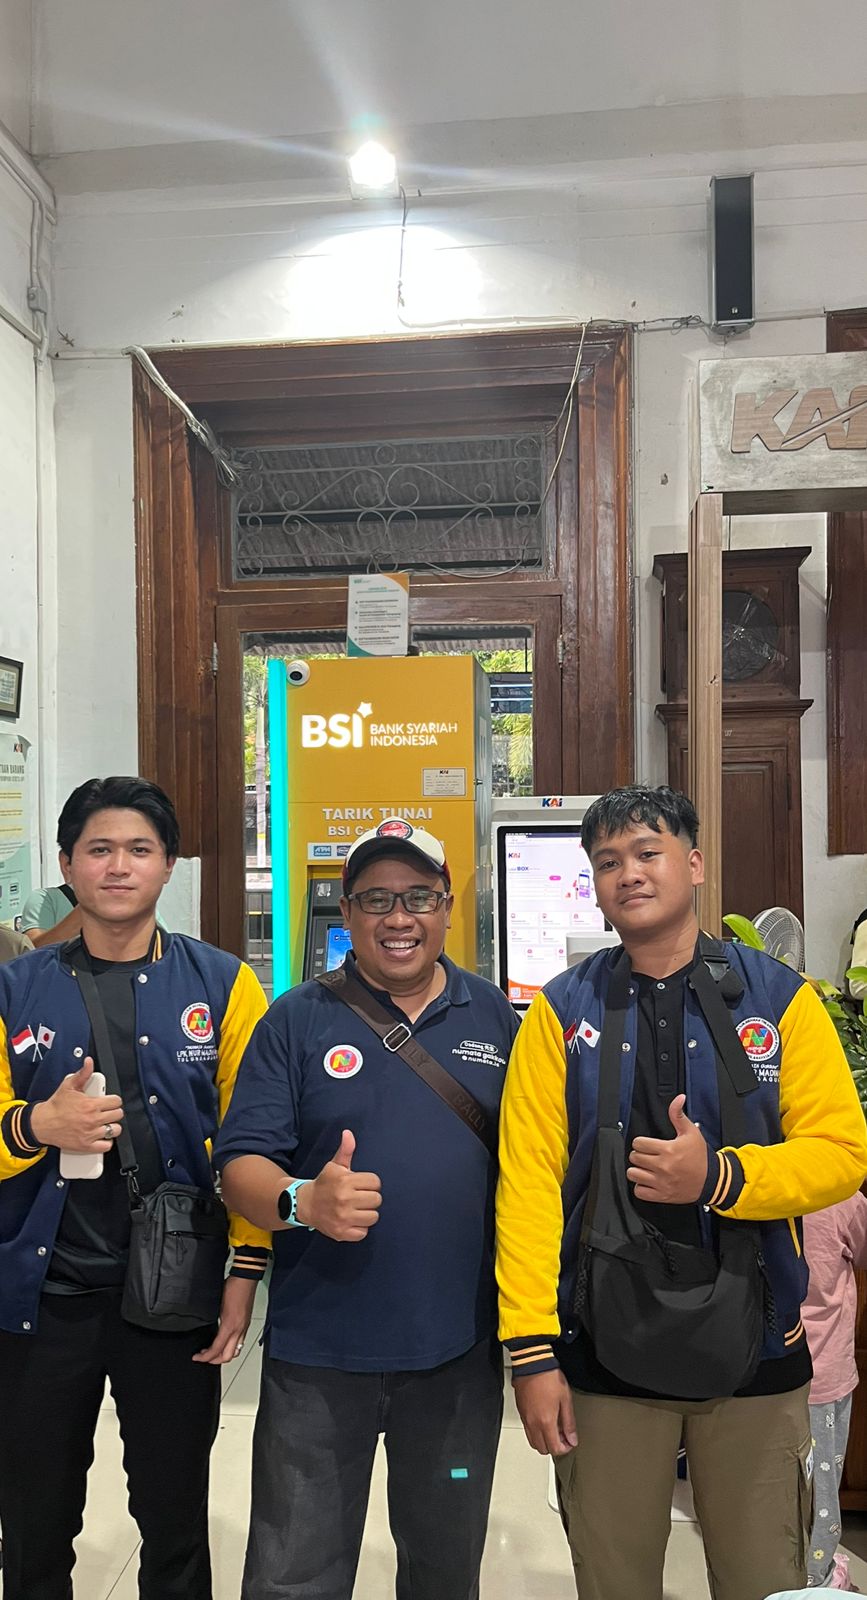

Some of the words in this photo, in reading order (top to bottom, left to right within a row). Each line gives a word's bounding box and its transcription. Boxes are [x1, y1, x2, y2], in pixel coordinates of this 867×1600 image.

[302, 713, 363, 748] BSI
[370, 723, 404, 735] BANK
[406, 722, 458, 734] SYARIAH
[370, 735, 438, 747] INDONESIA
[322, 807, 374, 820] TARIK
[379, 807, 433, 820] TUNAI
[328, 826, 350, 836] BSI
